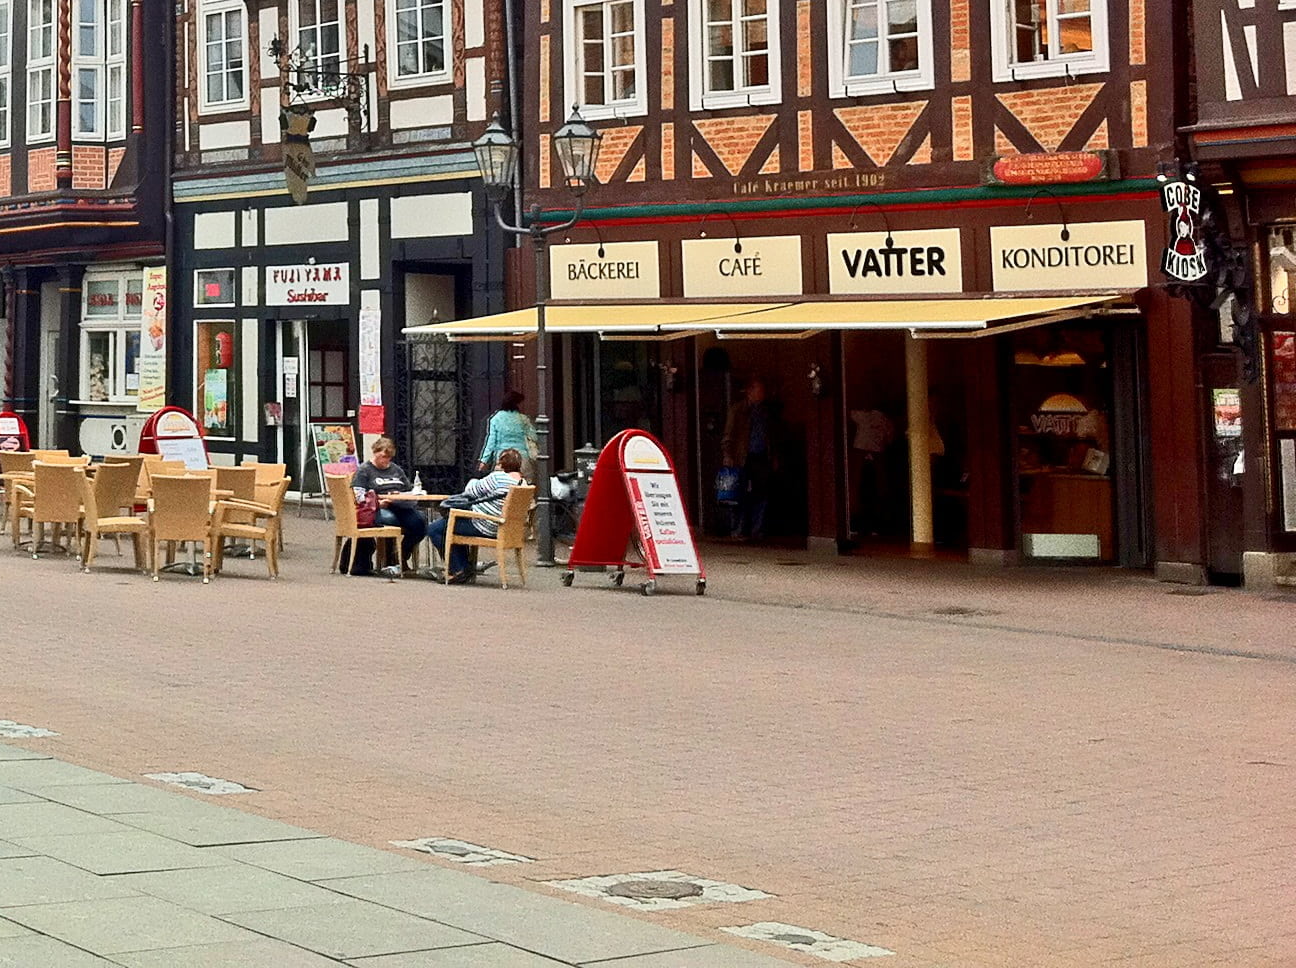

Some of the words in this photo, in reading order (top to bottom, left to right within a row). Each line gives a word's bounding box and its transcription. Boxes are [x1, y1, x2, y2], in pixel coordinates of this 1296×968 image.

[825, 176, 848, 189] seit
[856, 173, 885, 187] 1902
[718, 251, 763, 277] CAFÉ
[842, 246, 947, 278] VATTER
[1002, 244, 1135, 269] KONDITOREI
[1167, 251, 1206, 278] KIOSK
[567, 258, 640, 281] BÄCKEREI
